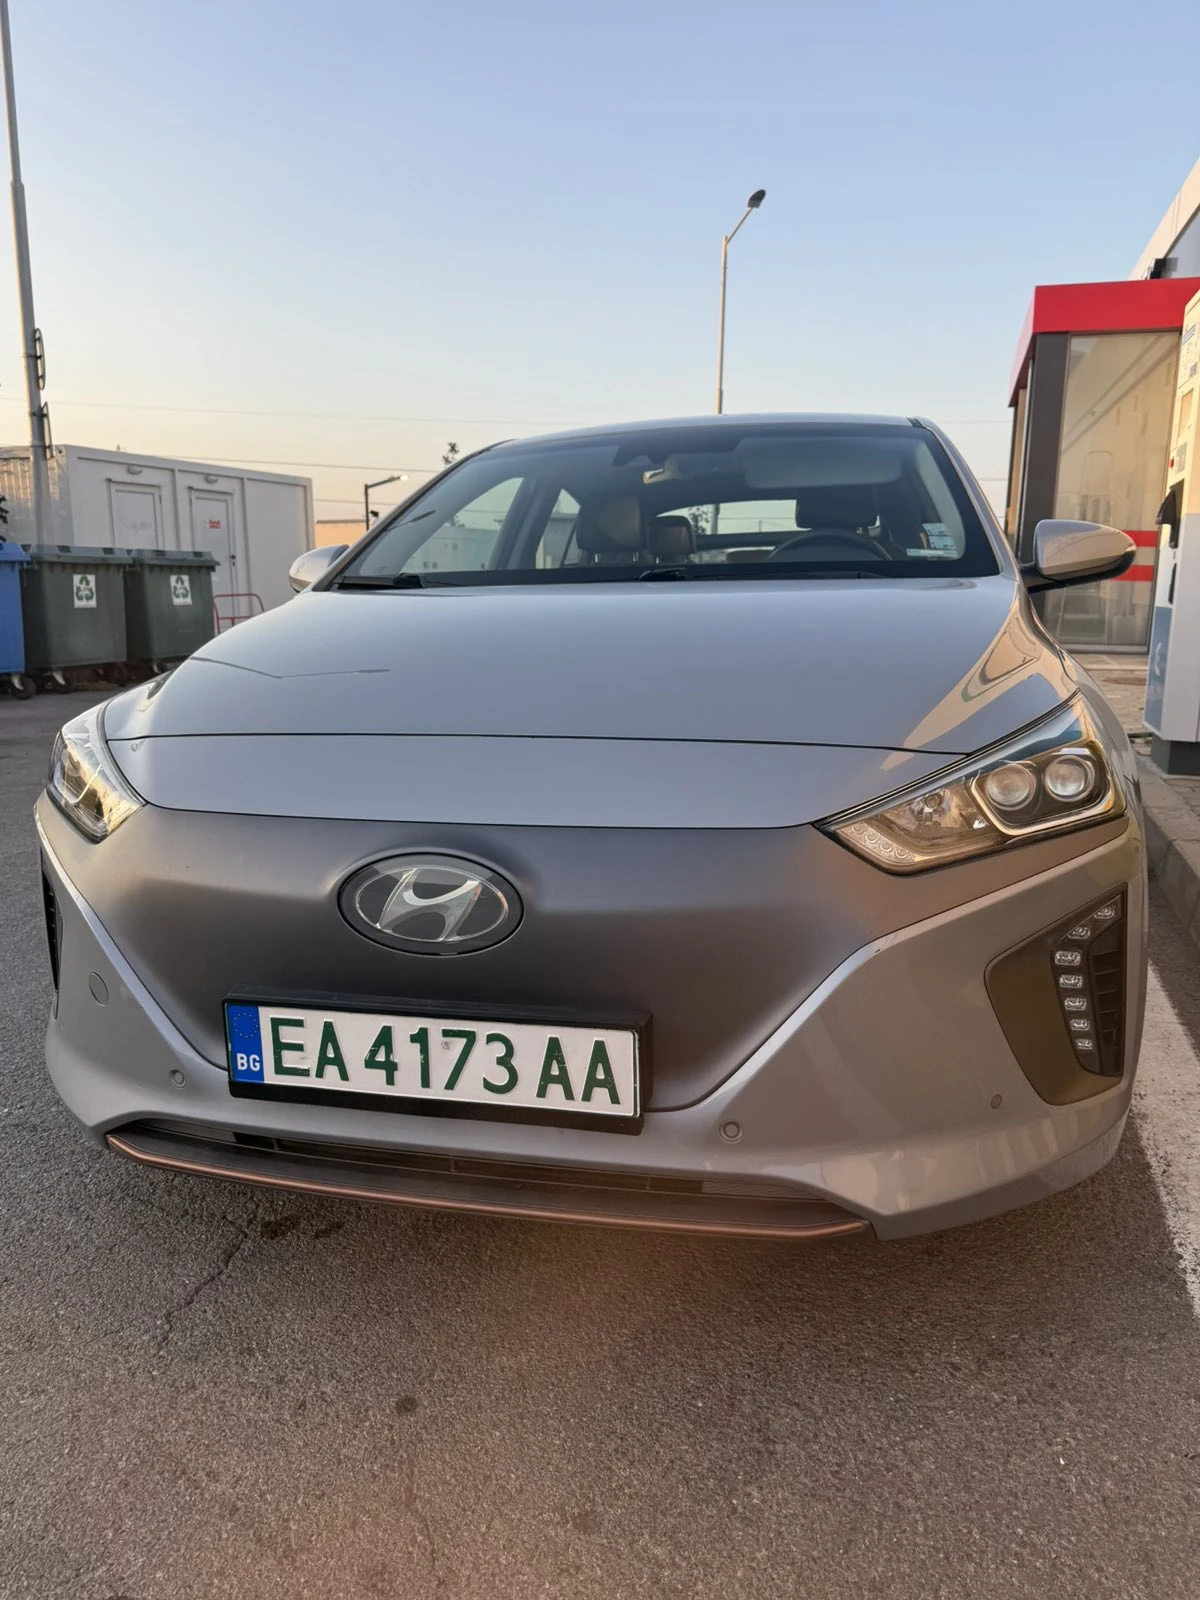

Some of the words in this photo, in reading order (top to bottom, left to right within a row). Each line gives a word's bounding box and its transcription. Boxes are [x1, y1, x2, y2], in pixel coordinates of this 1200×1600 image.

[236, 1053, 261, 1072] BG
[269, 1016, 350, 1082] EA
[364, 1024, 519, 1095] 4173
[536, 1036, 621, 1105] AA
